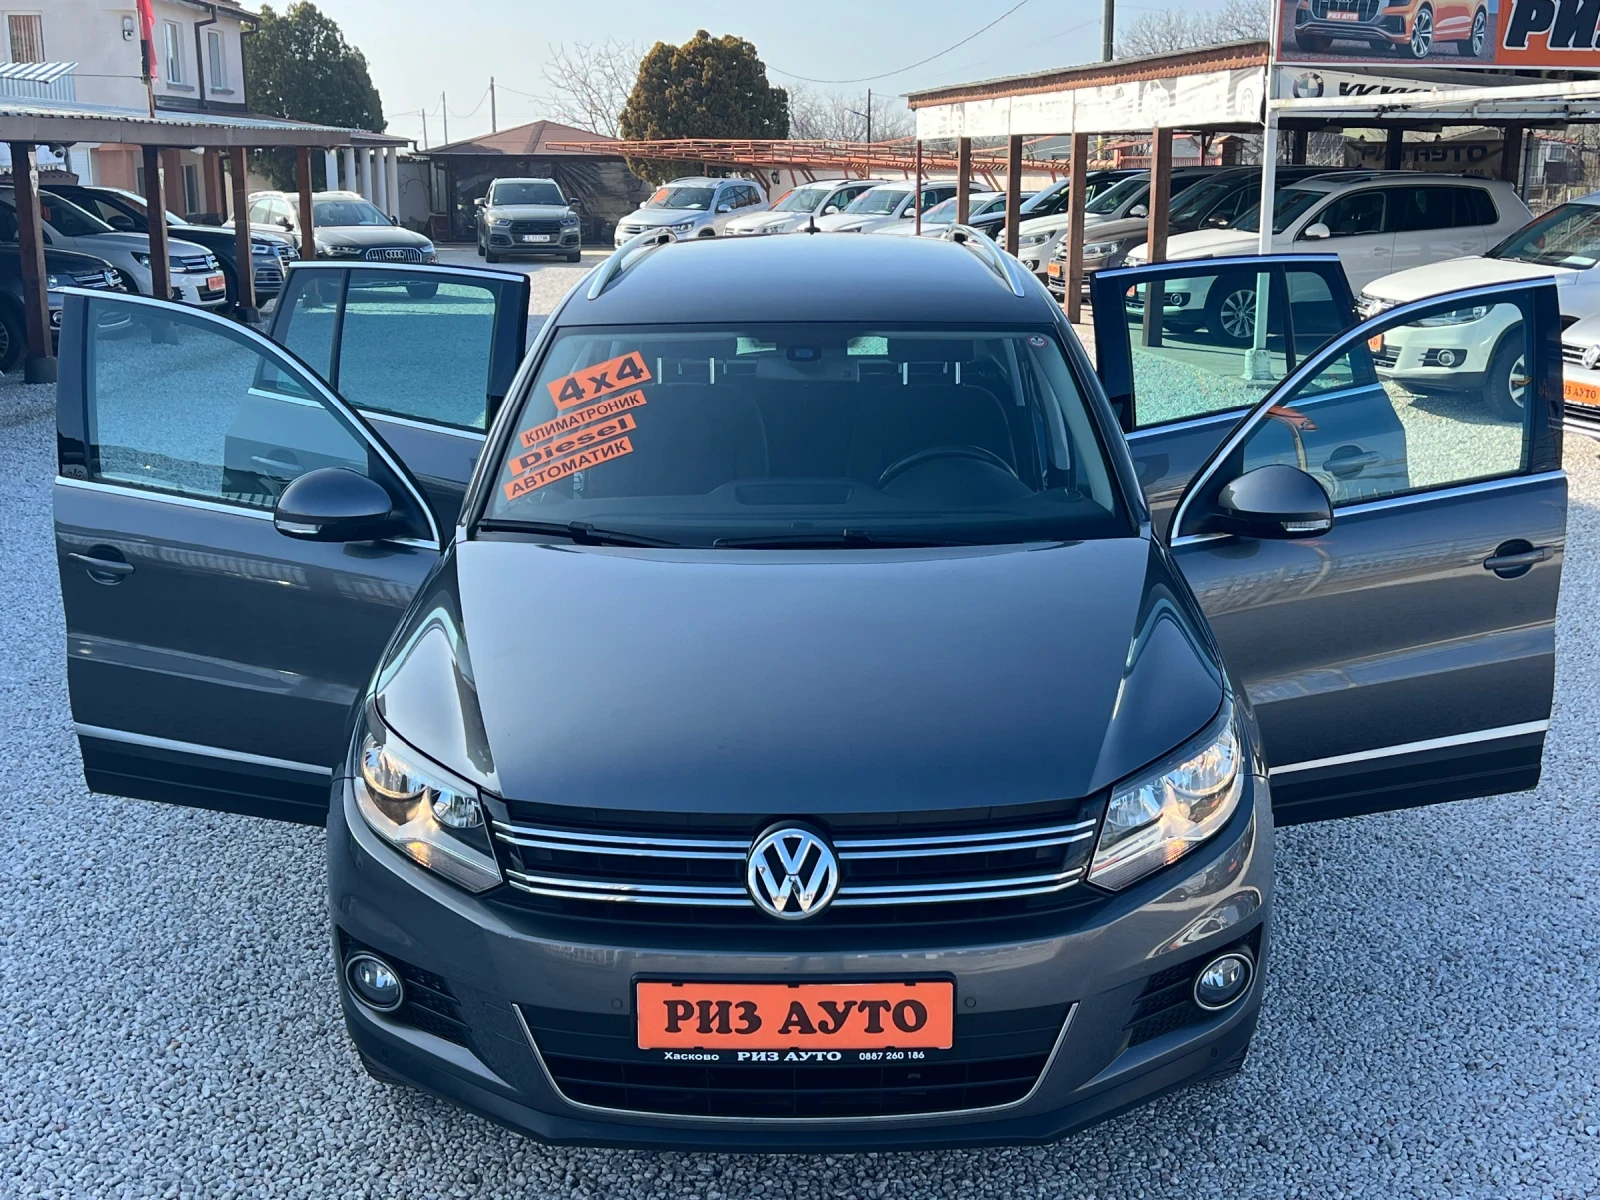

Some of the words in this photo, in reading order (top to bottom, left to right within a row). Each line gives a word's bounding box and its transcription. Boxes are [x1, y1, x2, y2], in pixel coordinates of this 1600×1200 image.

[1502, 0, 1600, 51] РИ
[525, 393, 641, 444] КЛИМАТРОНИК
[1573, 387, 1597, 399] АУТО
[511, 439, 628, 496] АВТОМАТИК
[518, 417, 629, 470] Diesel
[663, 999, 763, 1034] РИЗ
[777, 999, 929, 1035] АУТО
[664, 1051, 720, 1061] Хасково
[737, 1051, 780, 1062] РИЗ
[783, 1051, 842, 1062] АУТО
[858, 1051, 884, 1061] 0887
[885, 1051, 905, 1060] 260
[907, 1050, 925, 1060] 186
